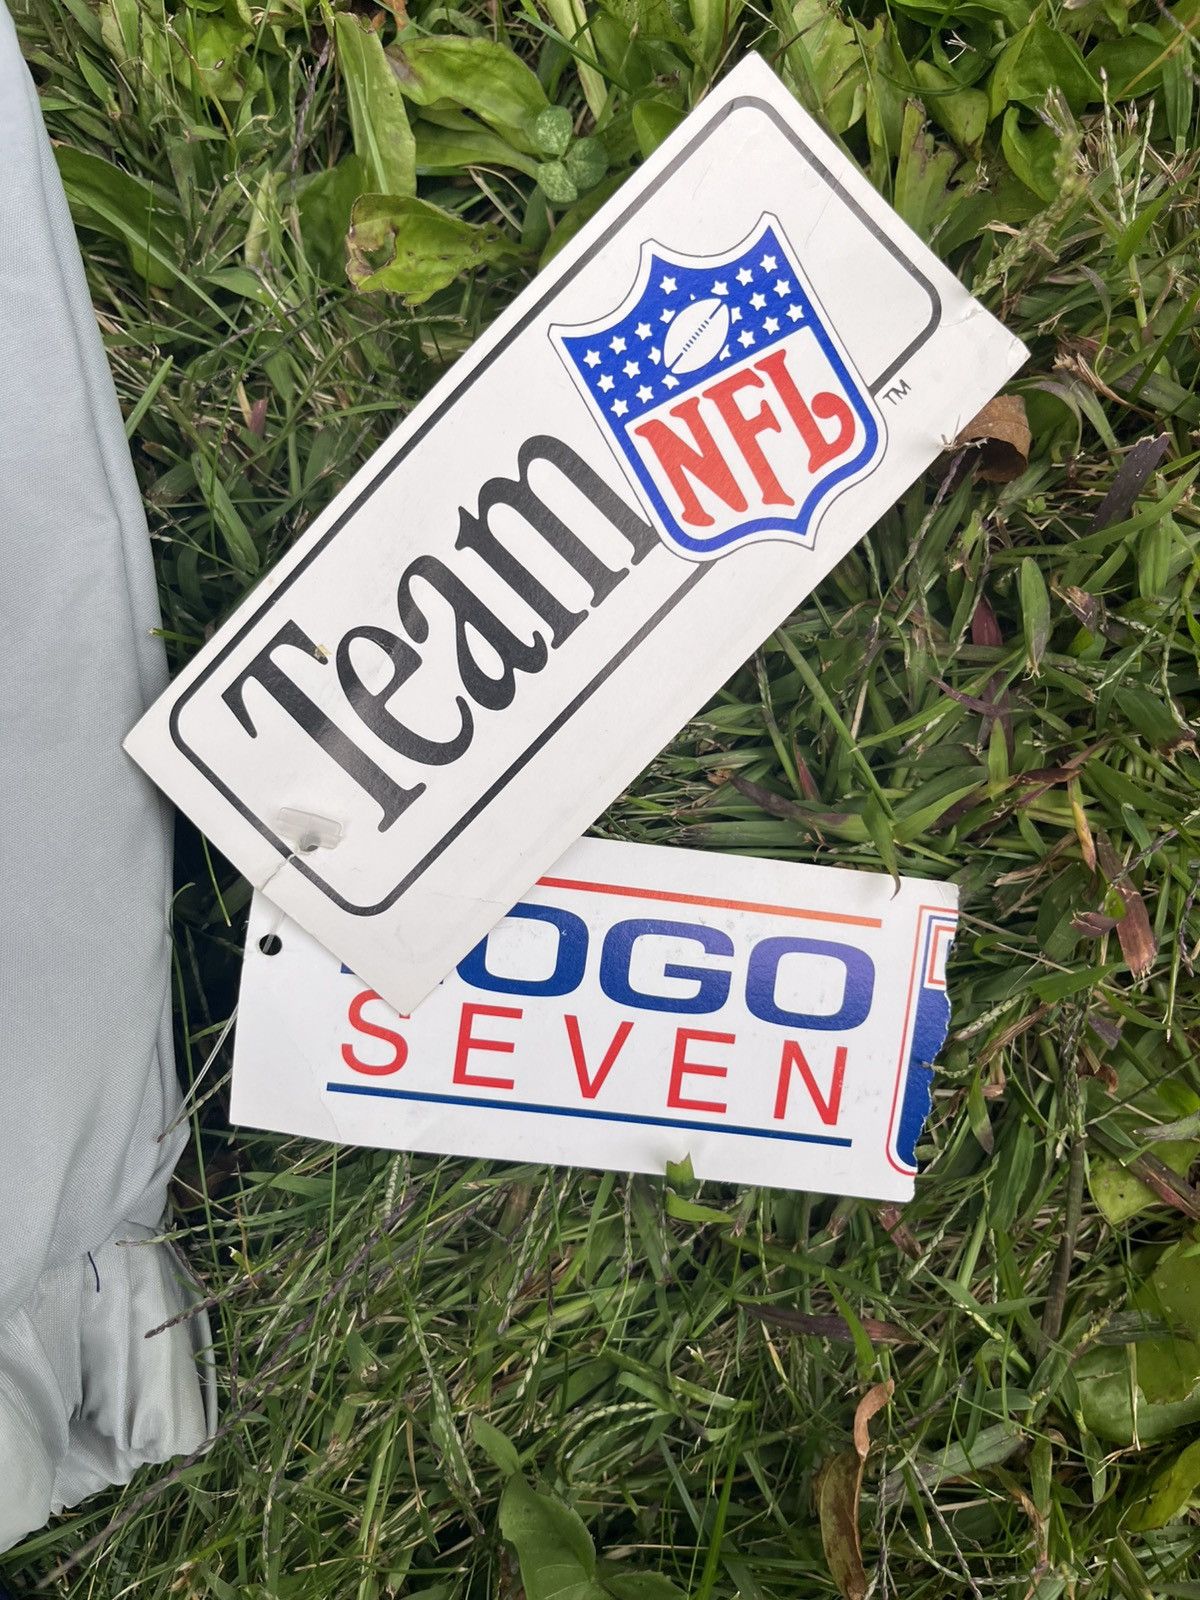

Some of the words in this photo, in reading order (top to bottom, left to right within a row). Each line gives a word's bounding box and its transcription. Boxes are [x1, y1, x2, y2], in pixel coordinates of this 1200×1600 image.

[221, 434, 661, 833] Team
[635, 349, 856, 527] NFL
[882, 378, 912, 406] TM
[340, 901, 876, 1031] OGO
[340, 989, 849, 1126] SEVEN
